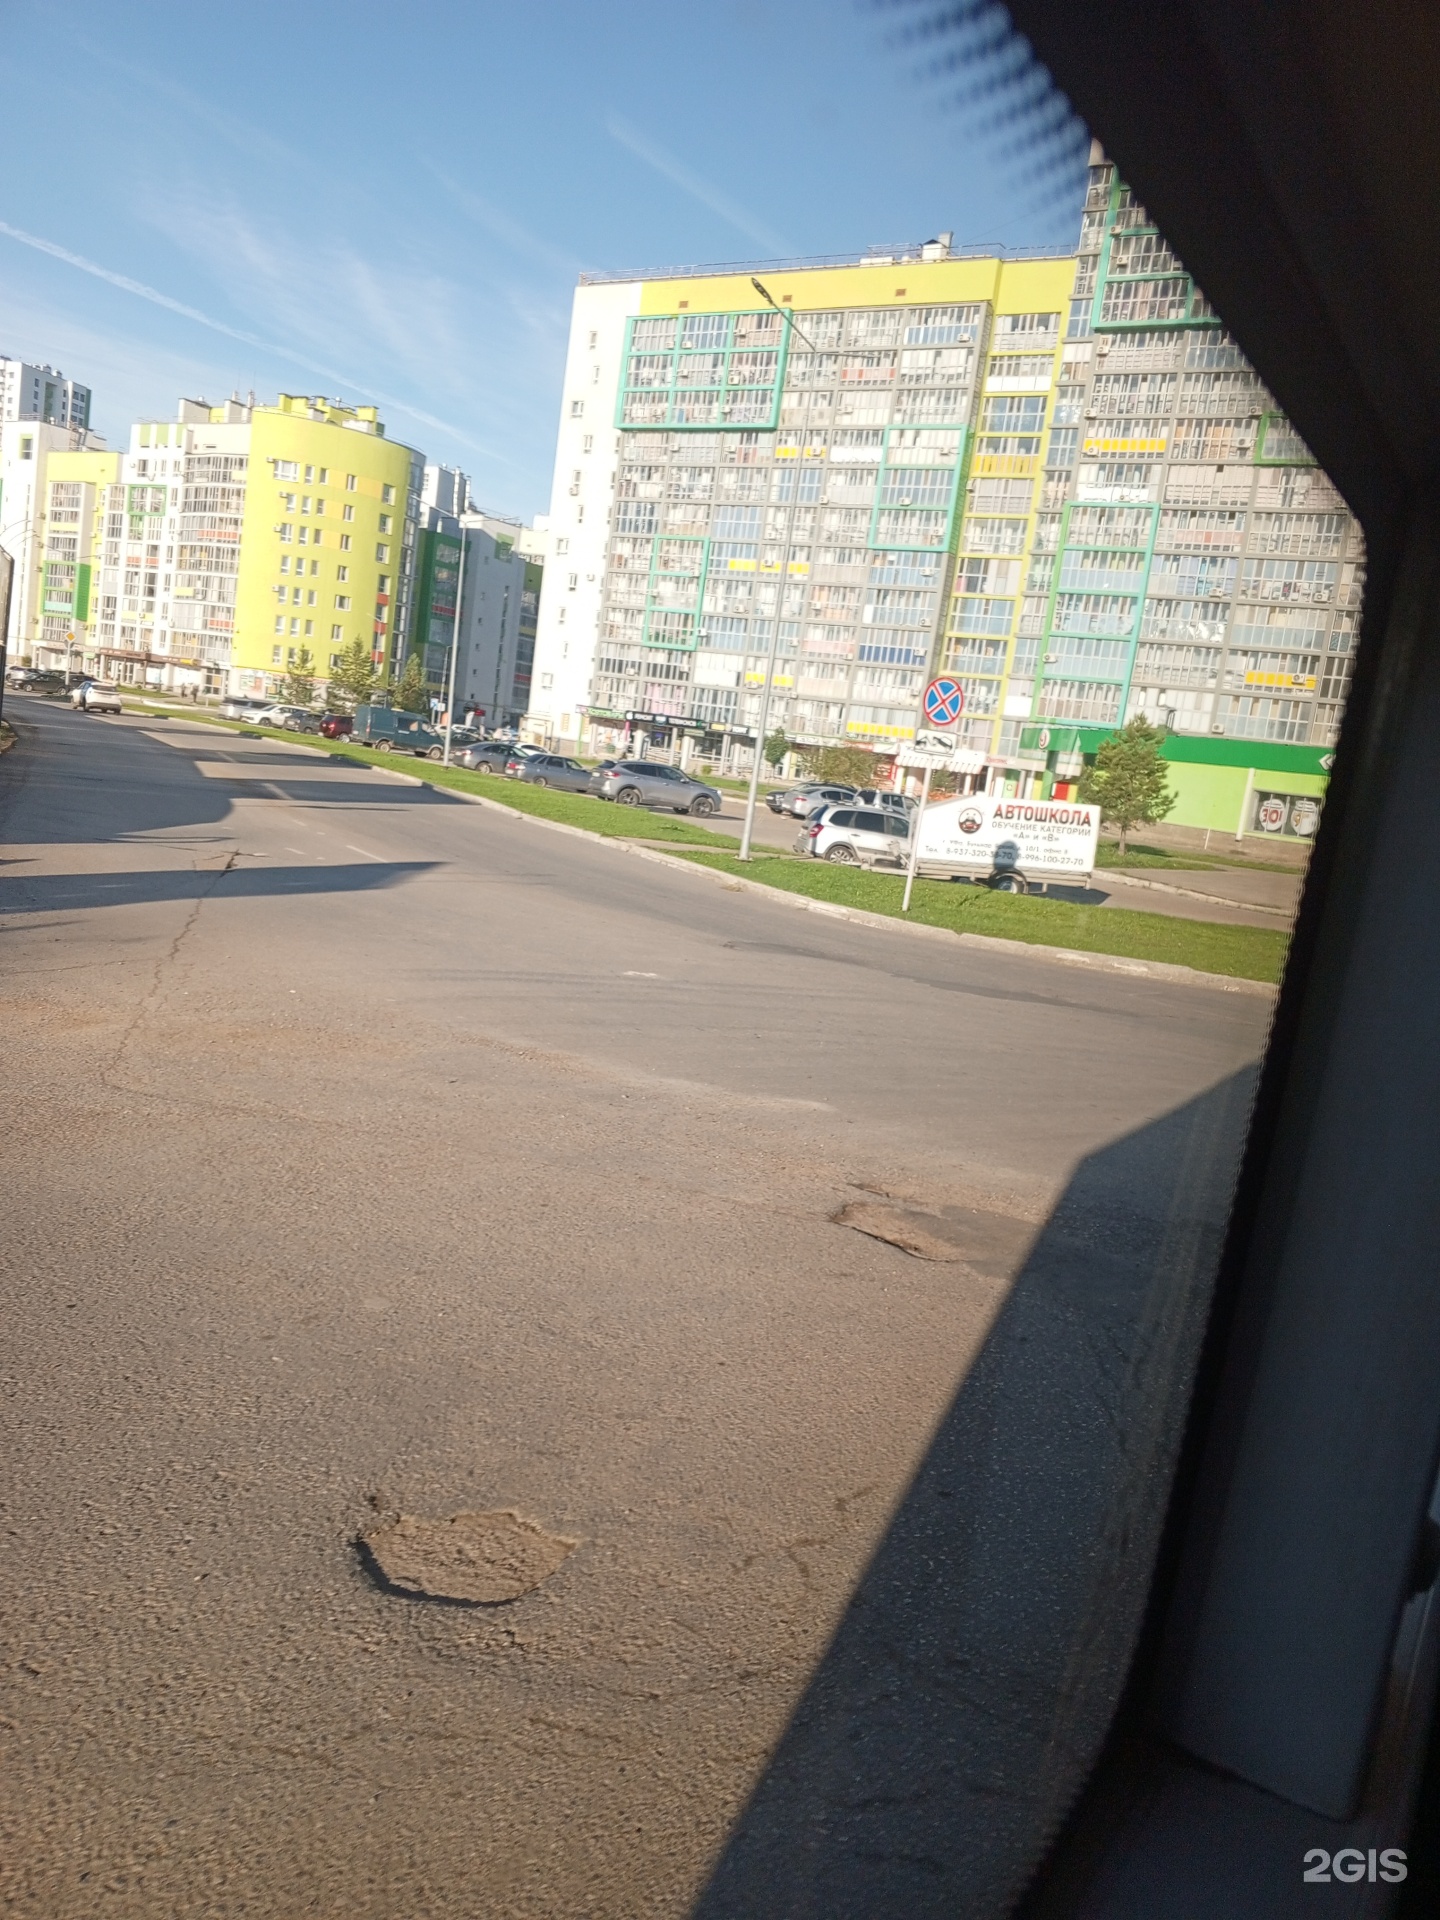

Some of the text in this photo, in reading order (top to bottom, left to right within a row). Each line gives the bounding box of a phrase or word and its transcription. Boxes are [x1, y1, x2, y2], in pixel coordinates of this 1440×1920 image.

[992, 804, 1092, 827] АВТОШКОЛА
[991, 821, 1091, 837] ОБУЧЕНИЕ КАТЕГОРИИ
